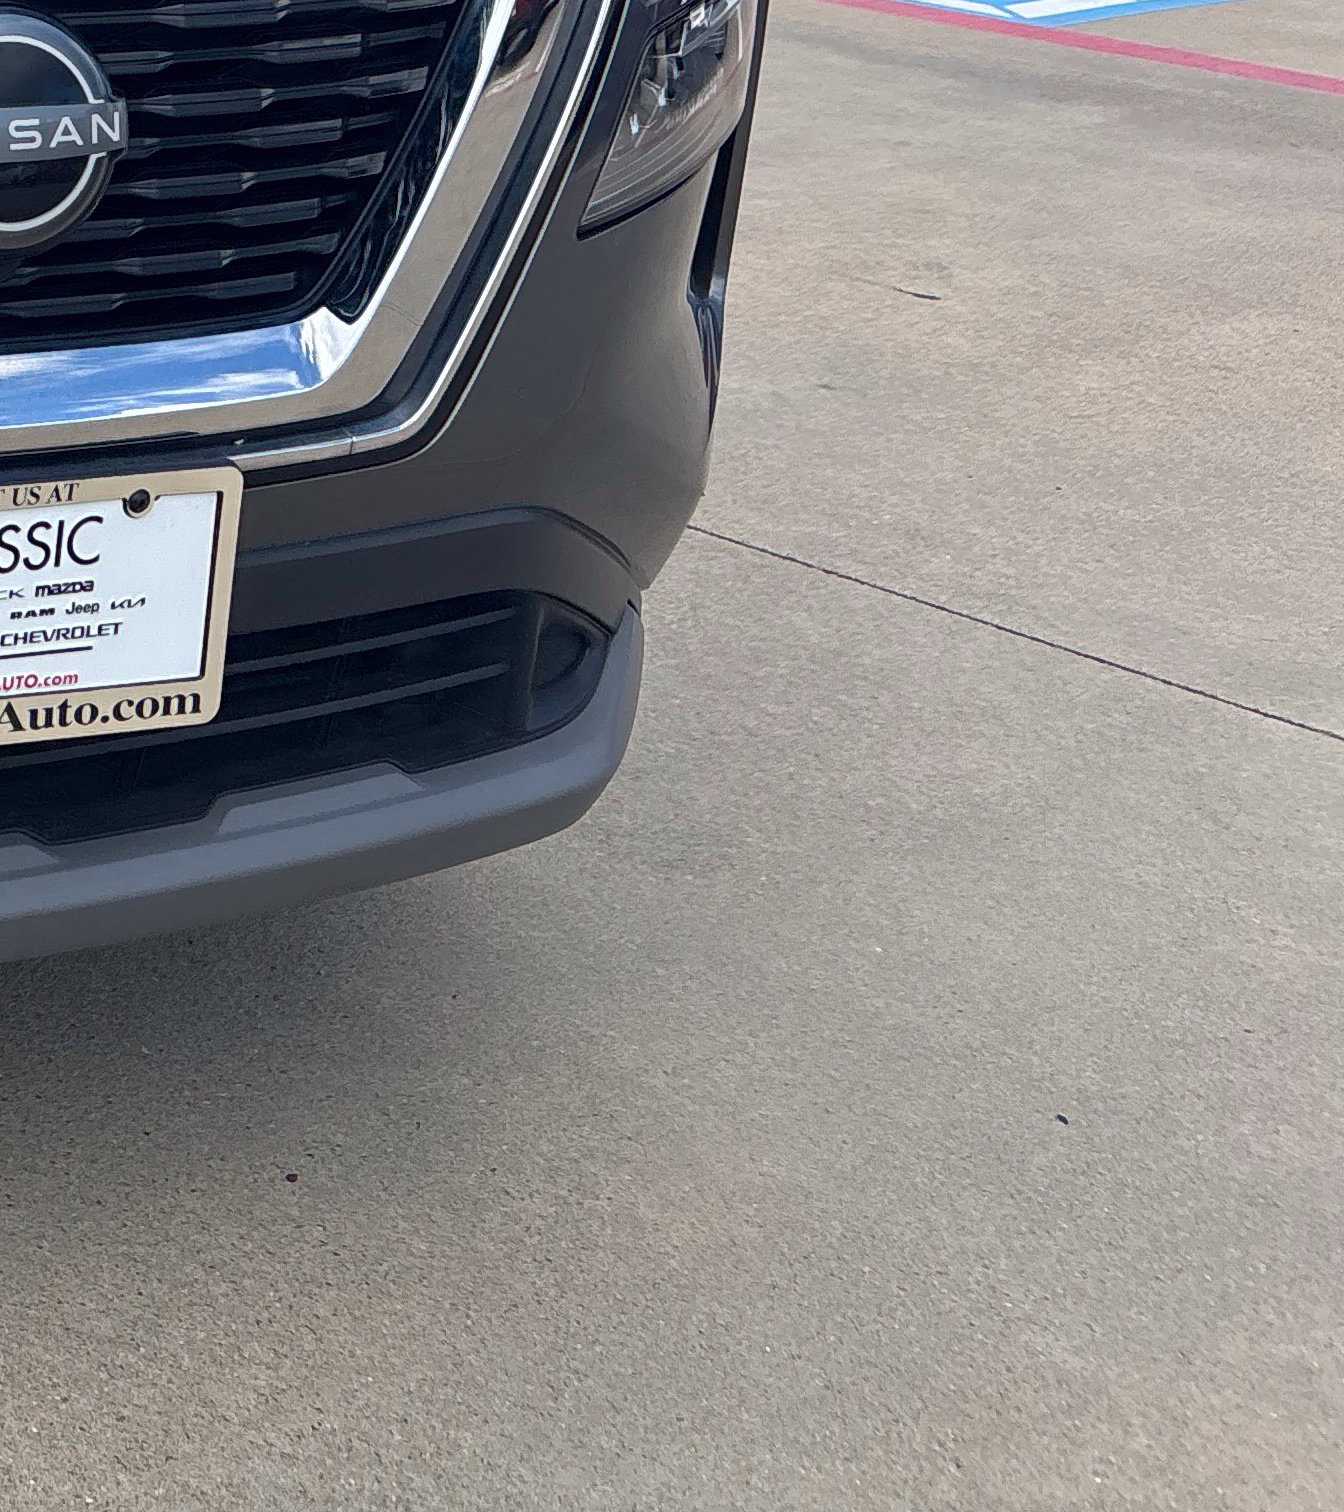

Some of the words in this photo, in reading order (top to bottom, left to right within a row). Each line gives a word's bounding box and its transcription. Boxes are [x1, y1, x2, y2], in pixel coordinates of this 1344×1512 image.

[12, 486, 43, 507] US
[47, 483, 80, 504] AT
[34, 580, 95, 598] mazda
[10, 607, 56, 621] RAM
[65, 601, 101, 617] Jeep
[110, 597, 147, 610] KIA
[0, 621, 124, 648] CHEVROLET
